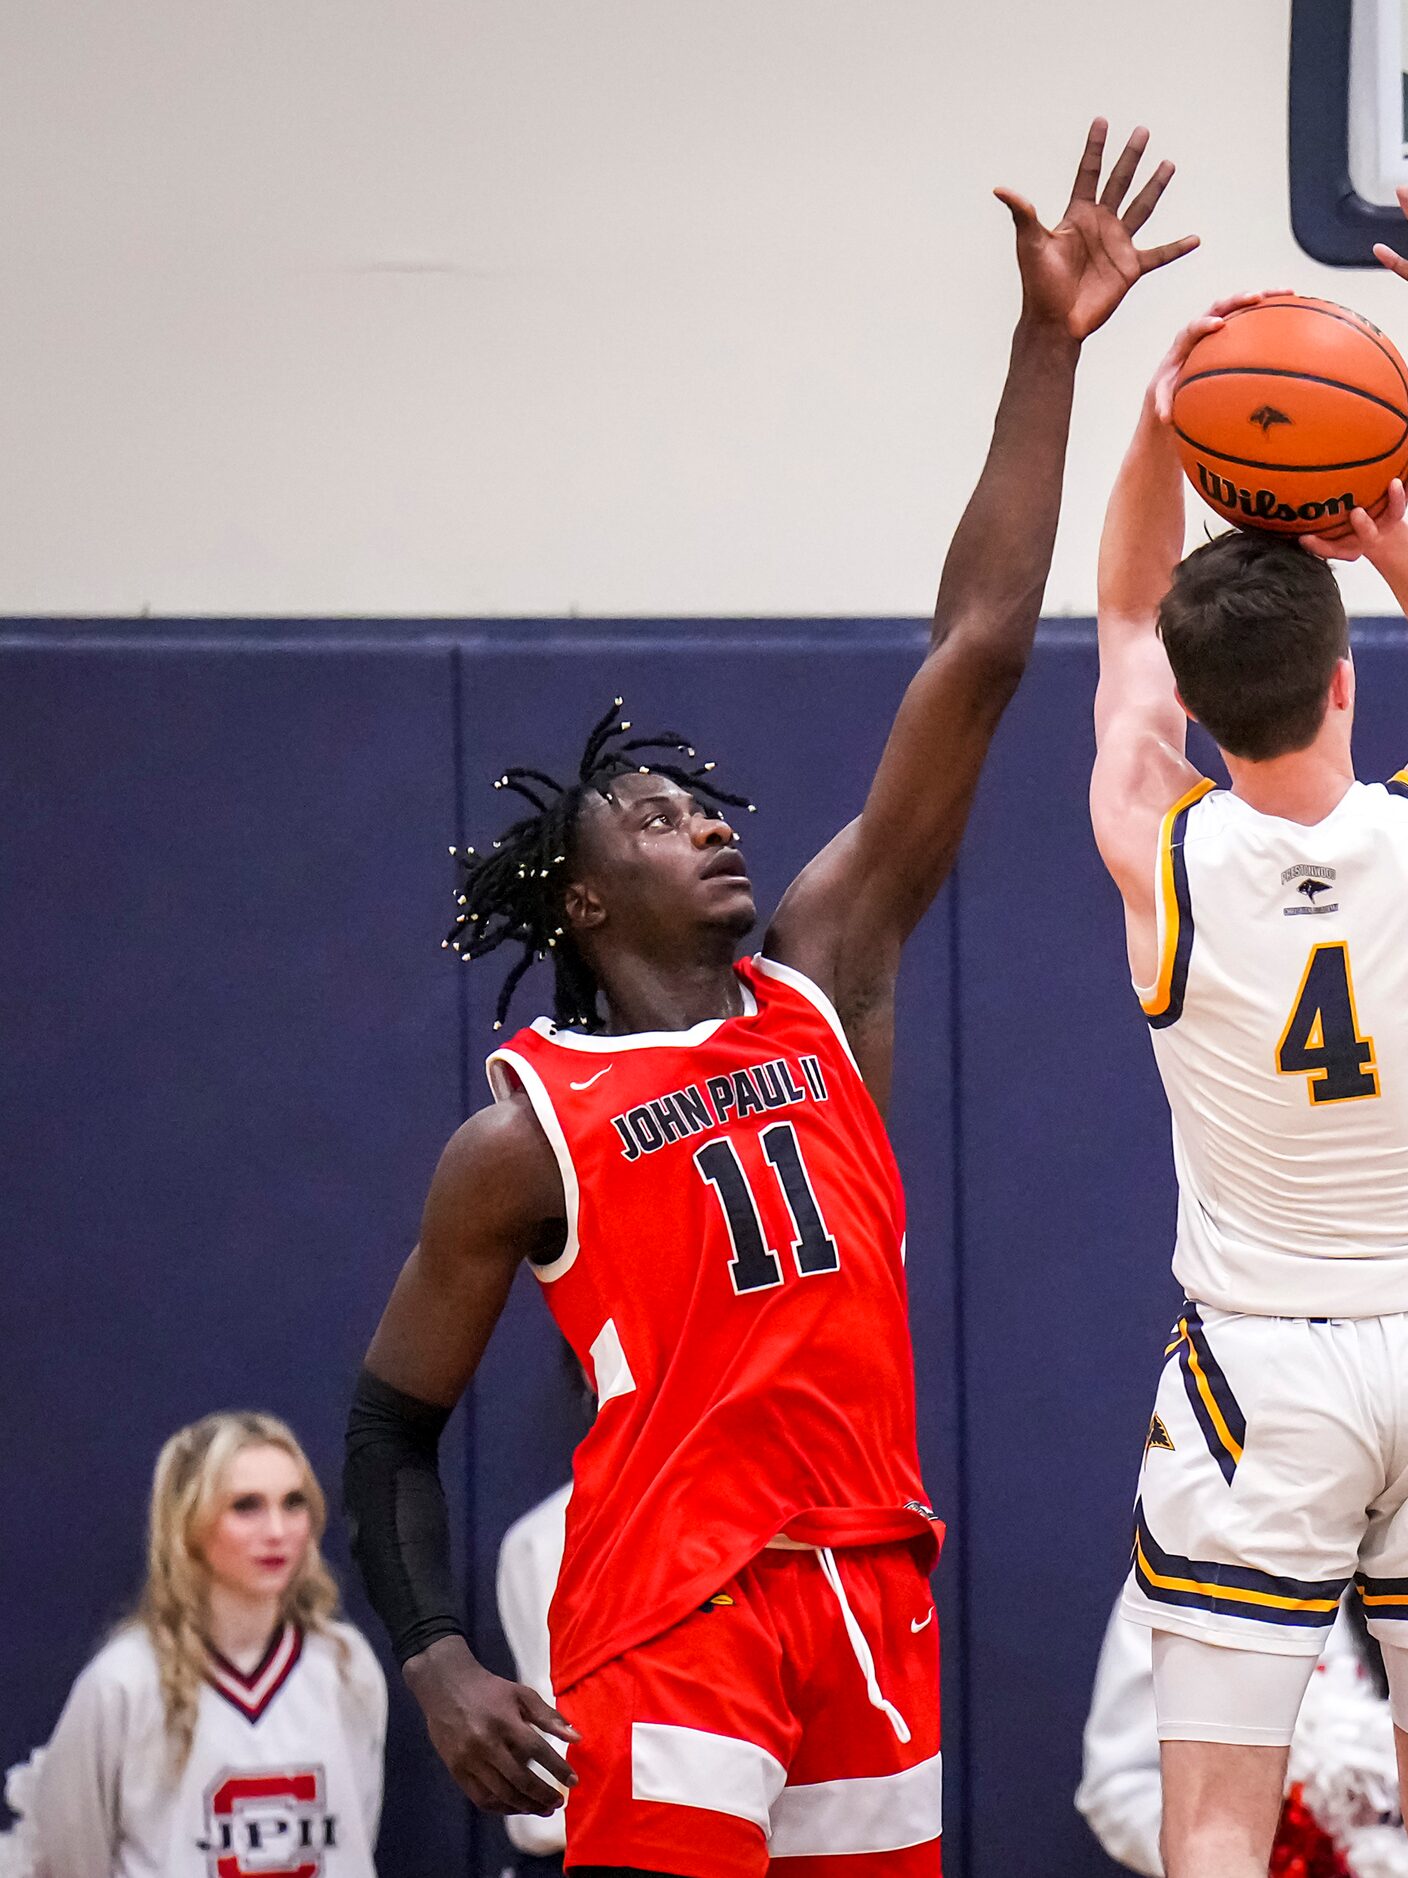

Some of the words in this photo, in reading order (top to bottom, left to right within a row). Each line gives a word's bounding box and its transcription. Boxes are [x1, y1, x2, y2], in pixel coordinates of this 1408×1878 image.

[1197, 462, 1357, 521] Wilson
[1274, 940, 1381, 1106] 4
[610, 1084, 714, 1162] JOHN
[706, 1058, 805, 1123] PAUL
[692, 1120, 841, 1296] 11
[195, 1813, 336, 1850] JPII
